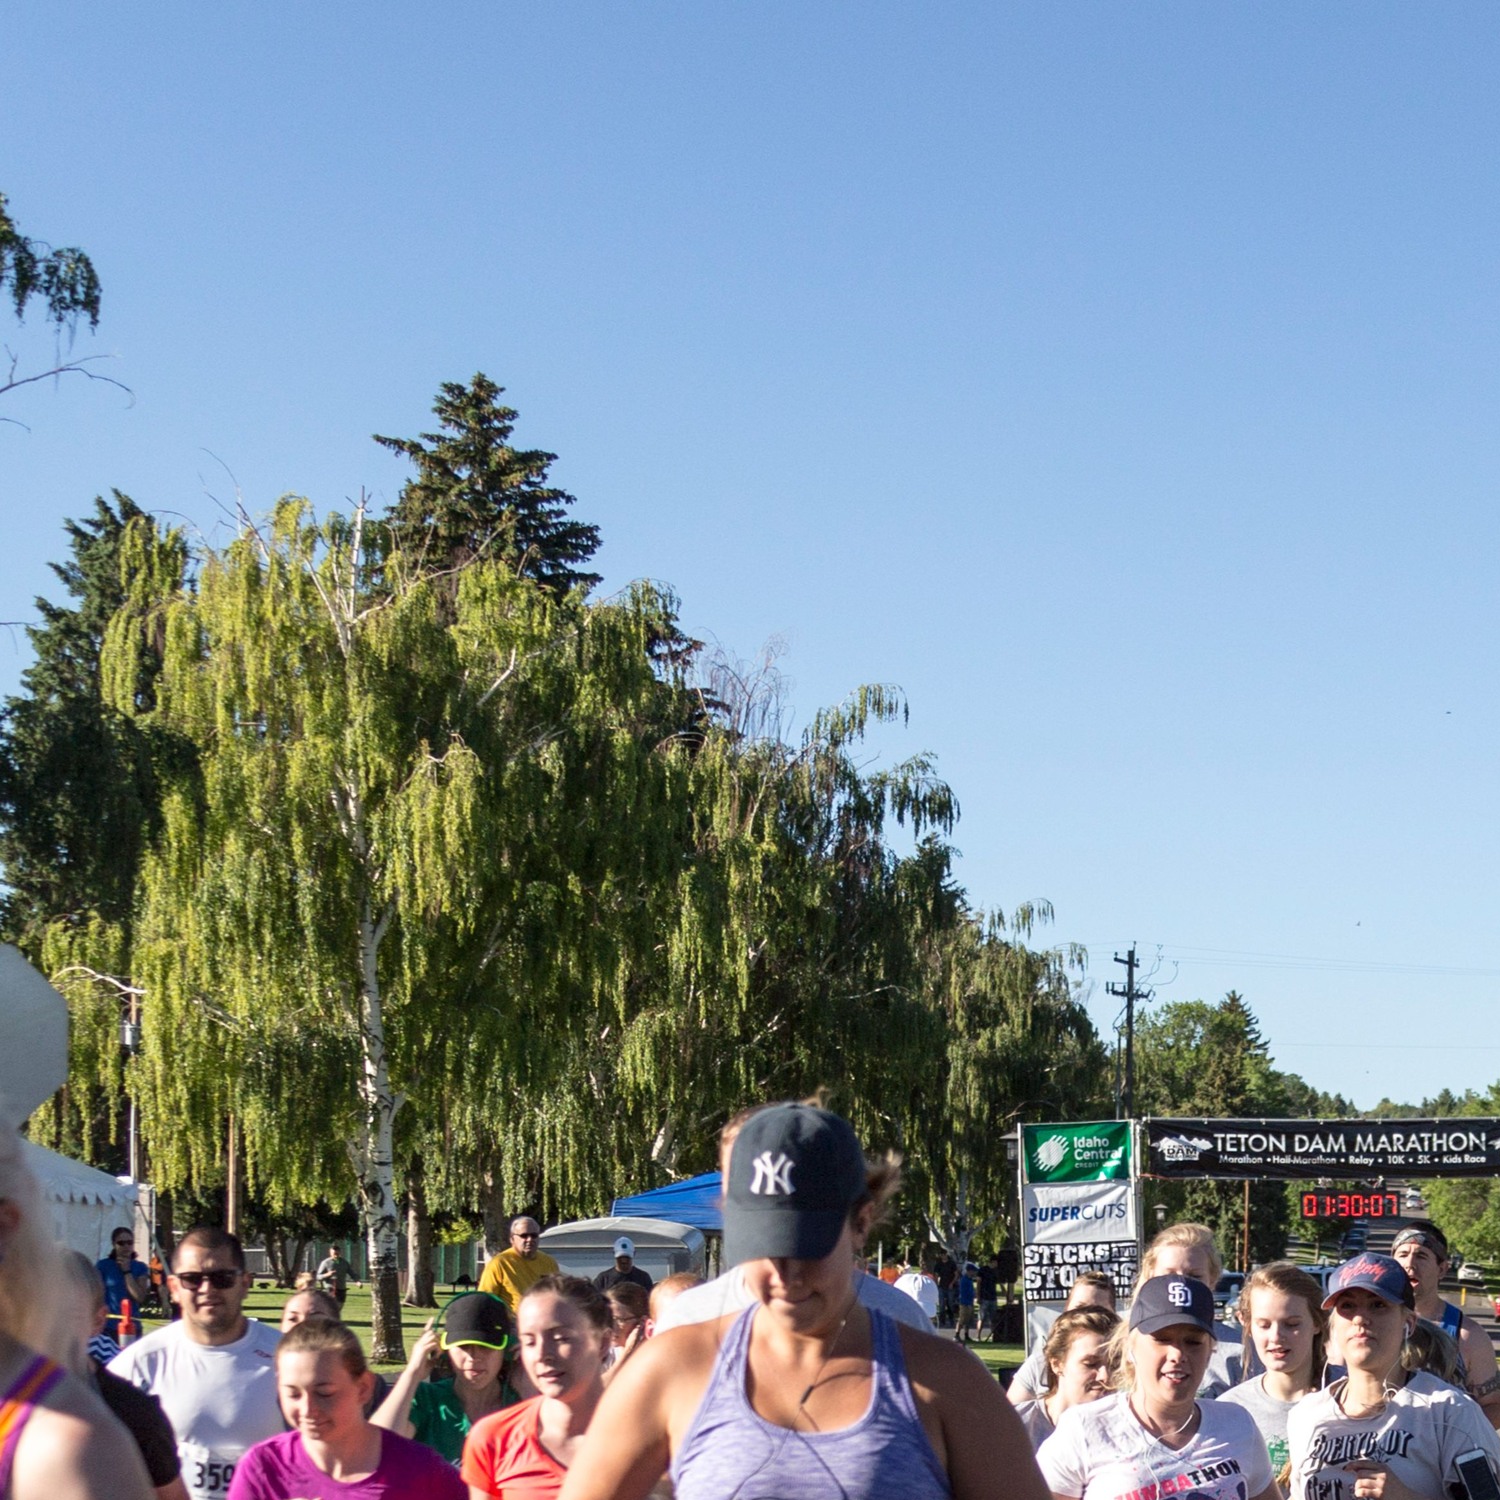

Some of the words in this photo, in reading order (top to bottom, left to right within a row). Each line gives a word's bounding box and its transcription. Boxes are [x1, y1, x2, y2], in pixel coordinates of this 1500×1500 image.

[1073, 1136, 1109, 1148] Idaho
[1213, 1133, 1290, 1152] TETON
[1295, 1133, 1346, 1152] DAM
[1354, 1132, 1486, 1152] MARATHON
[1074, 1147, 1123, 1161] Central
[1219, 1154, 1263, 1164] Marathon
[1349, 1155, 1375, 1167] Relay
[1387, 1155, 1406, 1165] 10K
[1417, 1154, 1431, 1164] 5K
[1443, 1154, 1462, 1164] Kids
[1464, 1154, 1487, 1164] Race
[750, 1150, 796, 1195] NY
[1028, 1202, 1126, 1223] SUPERCUTS
[1303, 1194, 1397, 1217] 01:30:07
[1024, 1243, 1110, 1265] STICKS
[1168, 1281, 1192, 1307] SD
